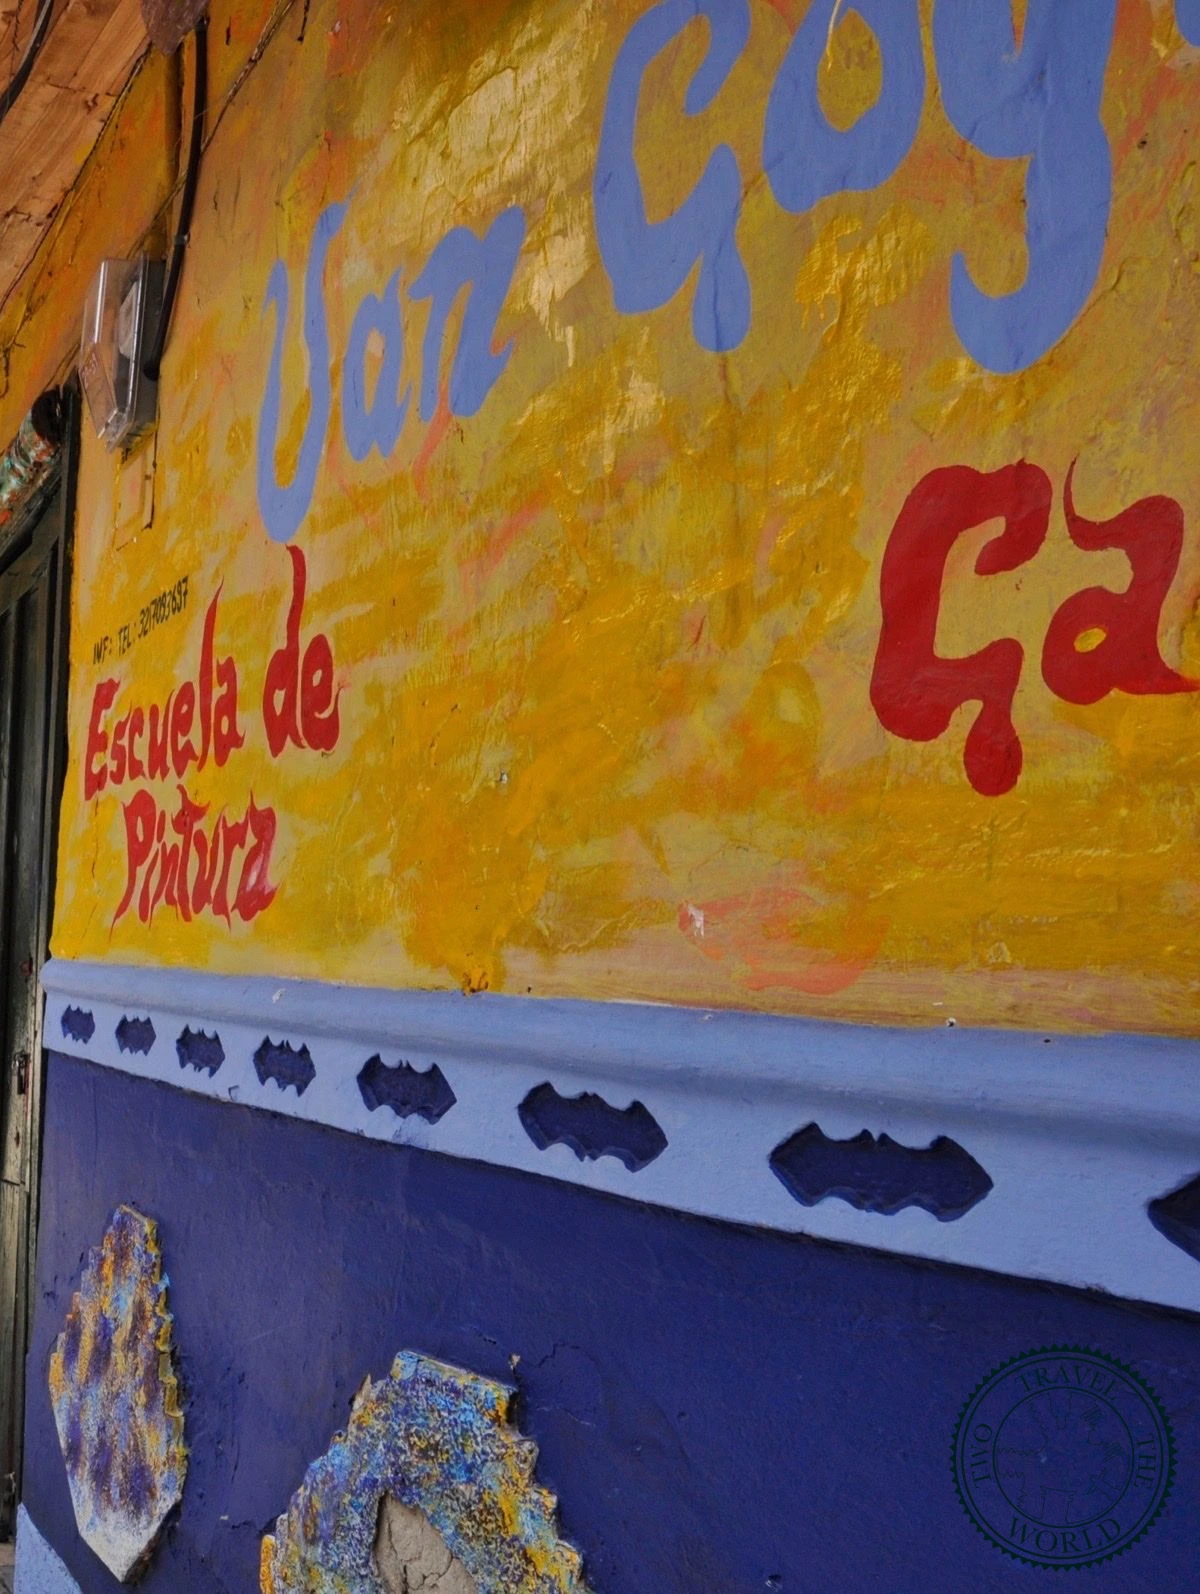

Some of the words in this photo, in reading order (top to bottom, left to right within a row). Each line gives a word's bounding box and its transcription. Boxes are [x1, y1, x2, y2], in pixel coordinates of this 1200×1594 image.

[257, 181, 526, 542] Van
[595, 0, 1200, 375] Goy
[84, 576, 246, 801] Escuela
[263, 544, 341, 758] de
[109, 784, 281, 936] Pintura
